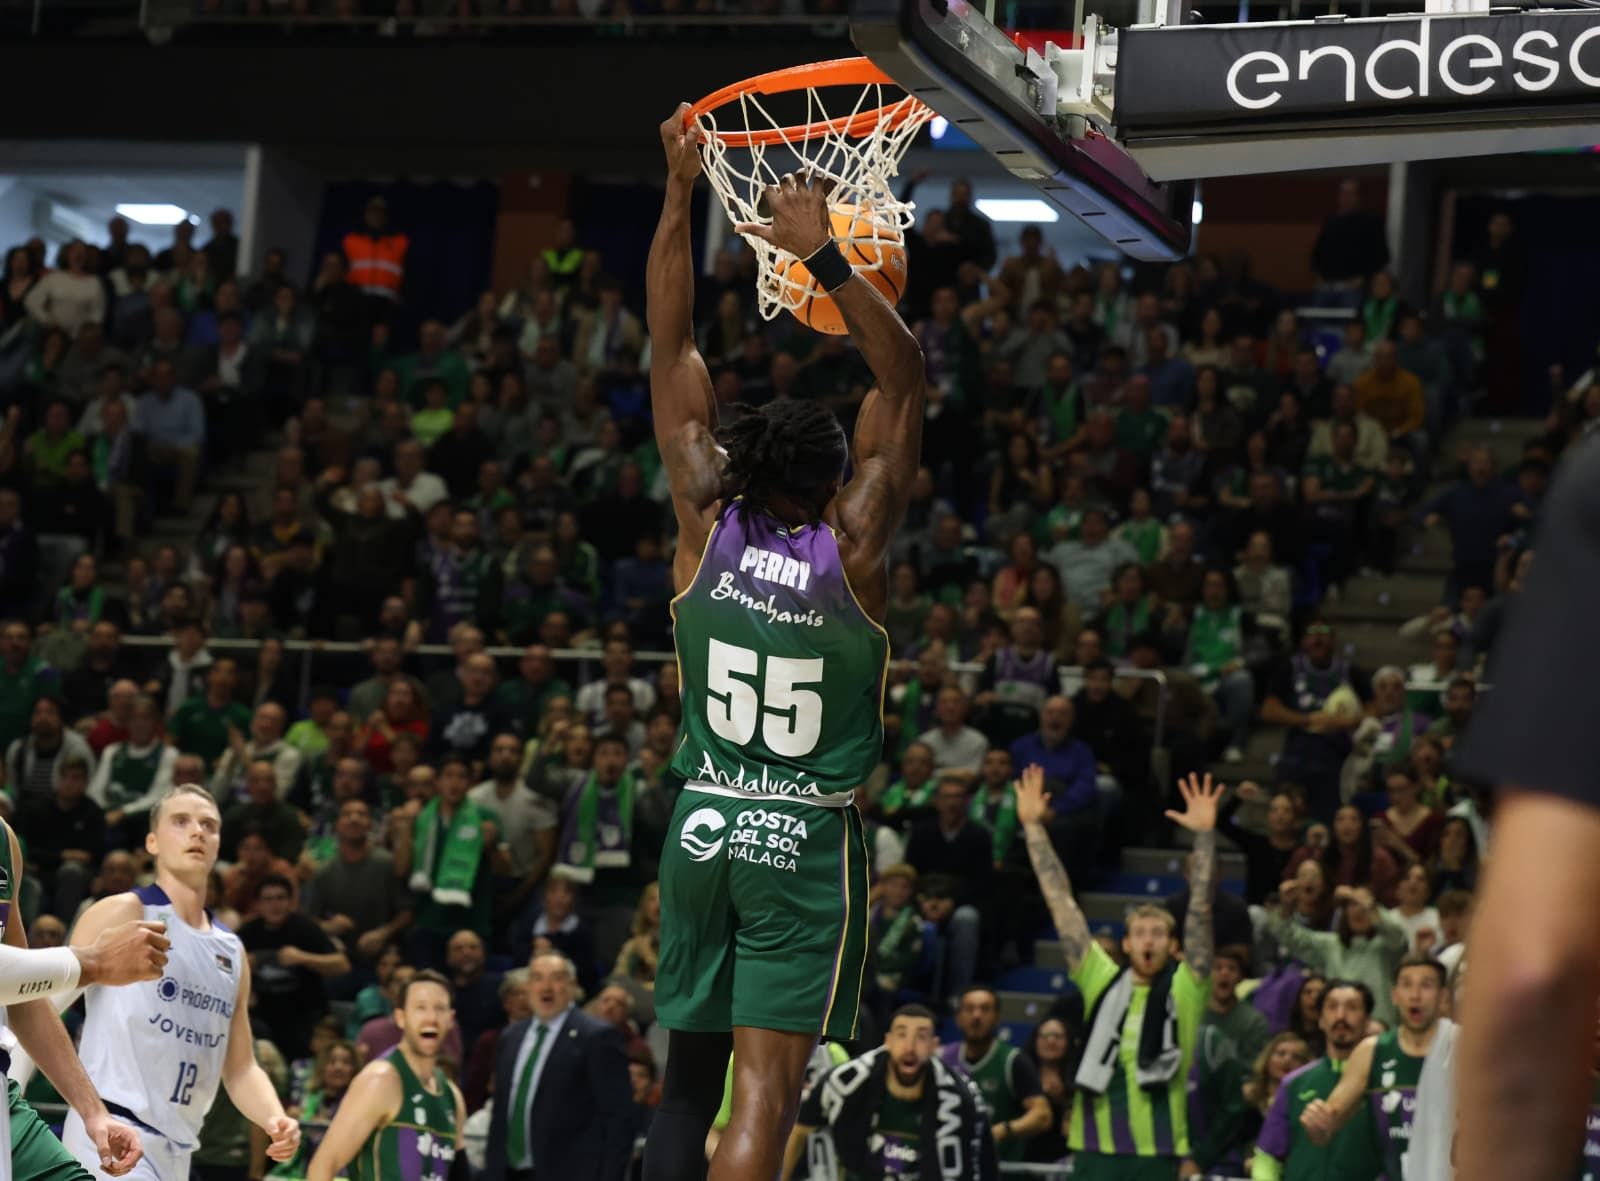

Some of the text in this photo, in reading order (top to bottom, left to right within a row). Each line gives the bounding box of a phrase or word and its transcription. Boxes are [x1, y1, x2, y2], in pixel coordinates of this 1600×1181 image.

[739, 545, 811, 590] PERRY
[706, 637, 824, 757] 55
[697, 750, 824, 797] Andalucía
[728, 829, 801, 857] DEL SOL
[736, 809, 808, 840] COSTA
[728, 843, 796, 873] MÁLAGA
[18, 980, 53, 995] KIPSTA
[169, 1060, 199, 1106] 12
